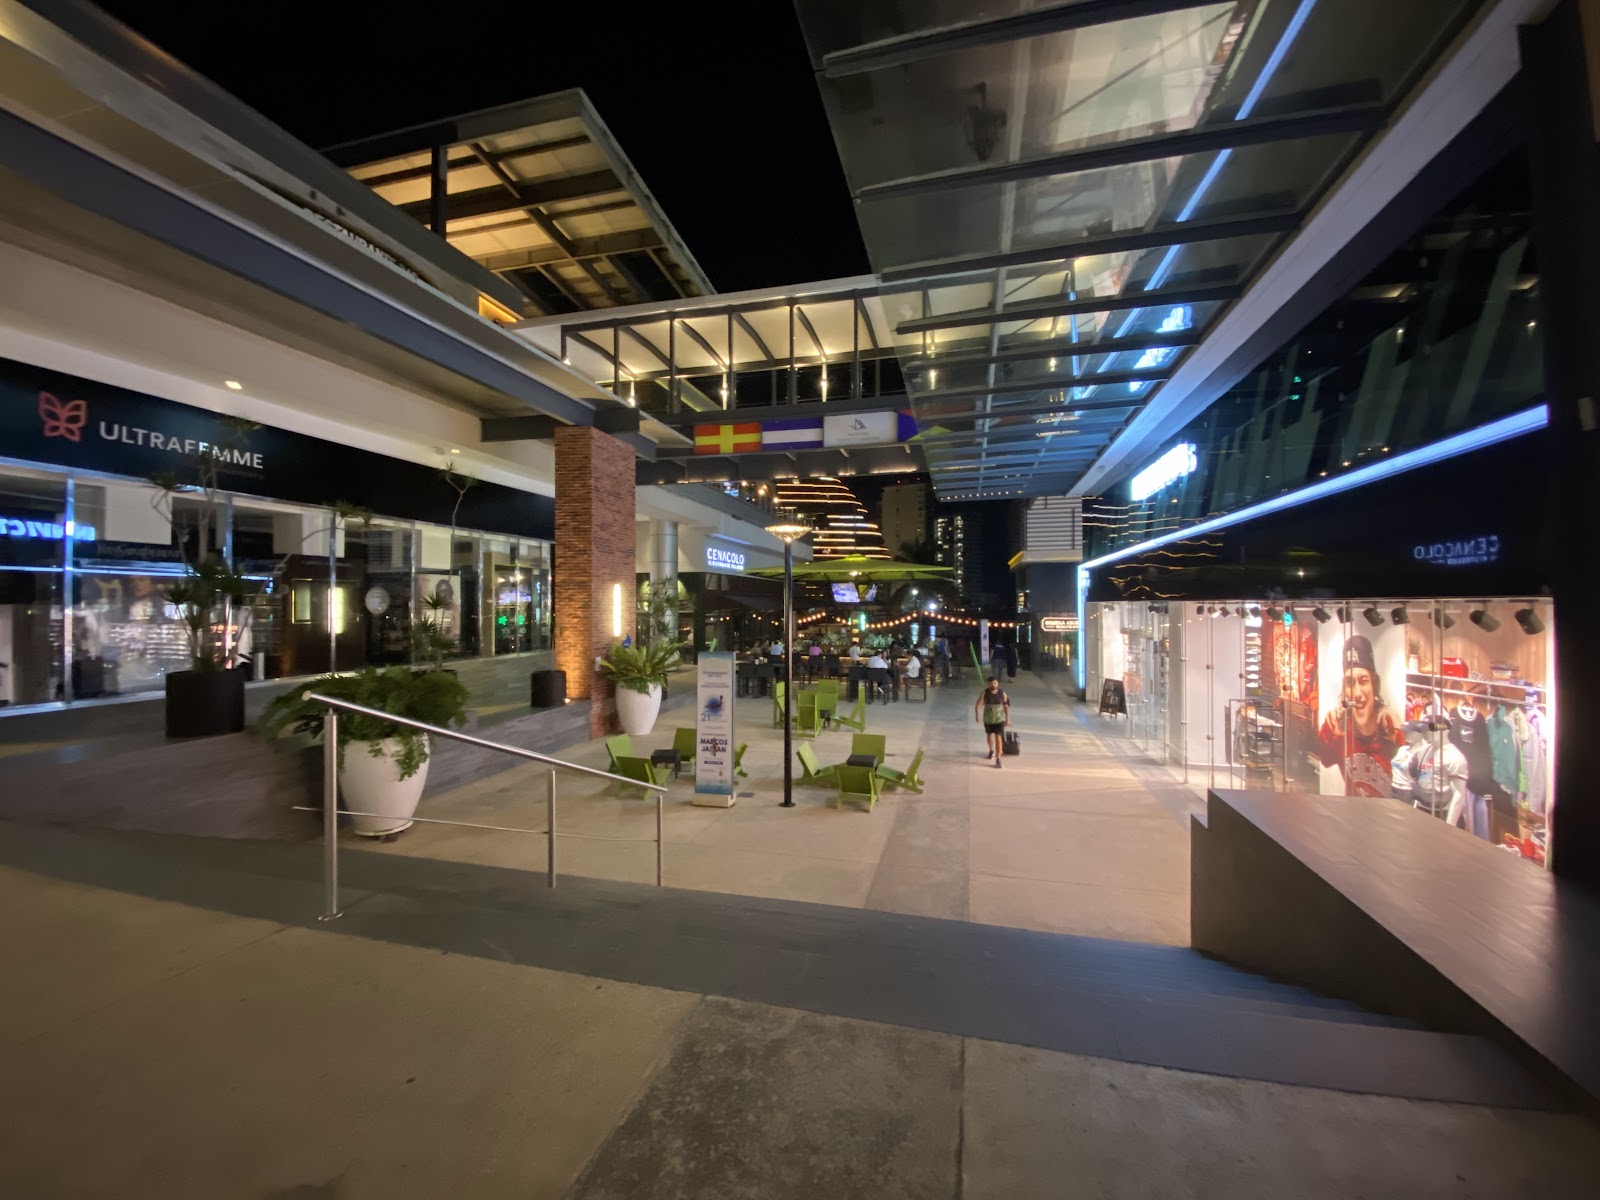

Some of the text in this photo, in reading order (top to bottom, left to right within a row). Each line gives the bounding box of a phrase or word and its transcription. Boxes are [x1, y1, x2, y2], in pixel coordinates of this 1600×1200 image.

[98, 421, 264, 469] ULTRAFEMME
[707, 548, 744, 565] CENACOLO
[700, 712, 711, 722] 21
